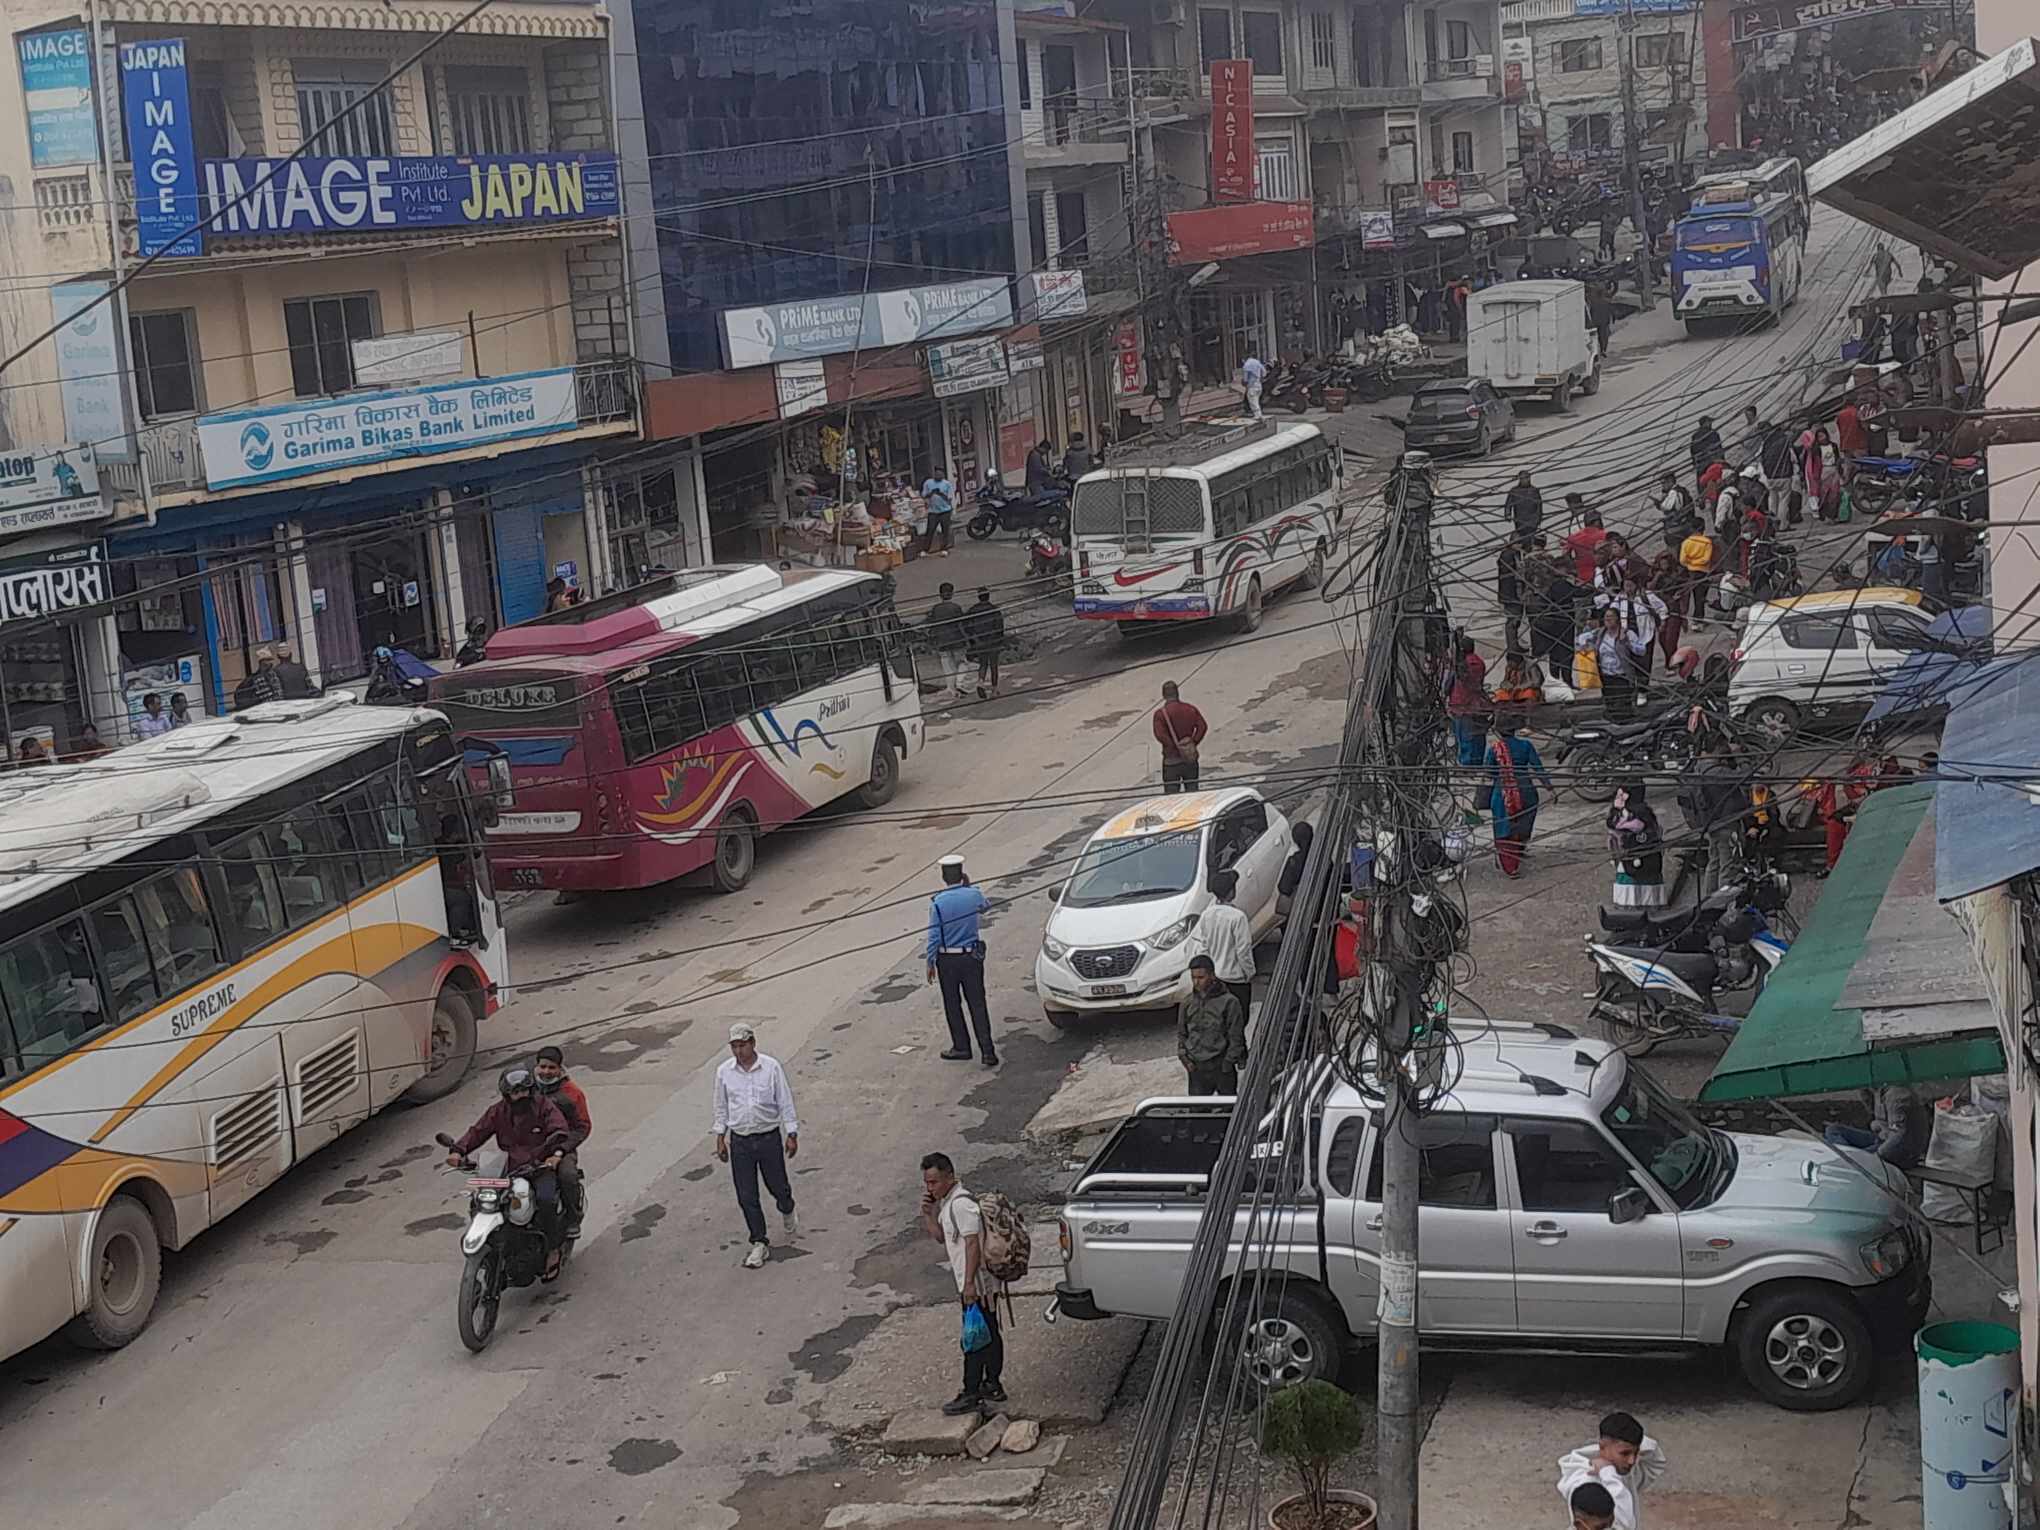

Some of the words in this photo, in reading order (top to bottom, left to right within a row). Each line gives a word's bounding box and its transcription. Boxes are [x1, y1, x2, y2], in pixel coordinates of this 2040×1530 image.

[20, 34, 86, 61] IMAGE
[122, 45, 185, 71] JAPAN
[143, 71, 180, 213] IMAGE
[204, 159, 397, 232] IMAGE
[399, 159, 449, 180] Institute
[401, 186, 426, 202] Pvt.
[427, 185, 452, 202] Ltd.
[461, 161, 584, 221] JAPAN
[280, 412, 346, 438] गरिमा
[355, 405, 421, 427] विकास
[470, 385, 533, 410] लिमिटेड
[284, 435, 356, 460] Garima
[361, 426, 414, 447] Bikas
[419, 416, 465, 437] Bank
[473, 404, 536, 430] Limited
[0, 545, 105, 624] प्लायर्स
[170, 982, 238, 1037] SUPREME
[1082, 1221, 1130, 1234] 4x4
